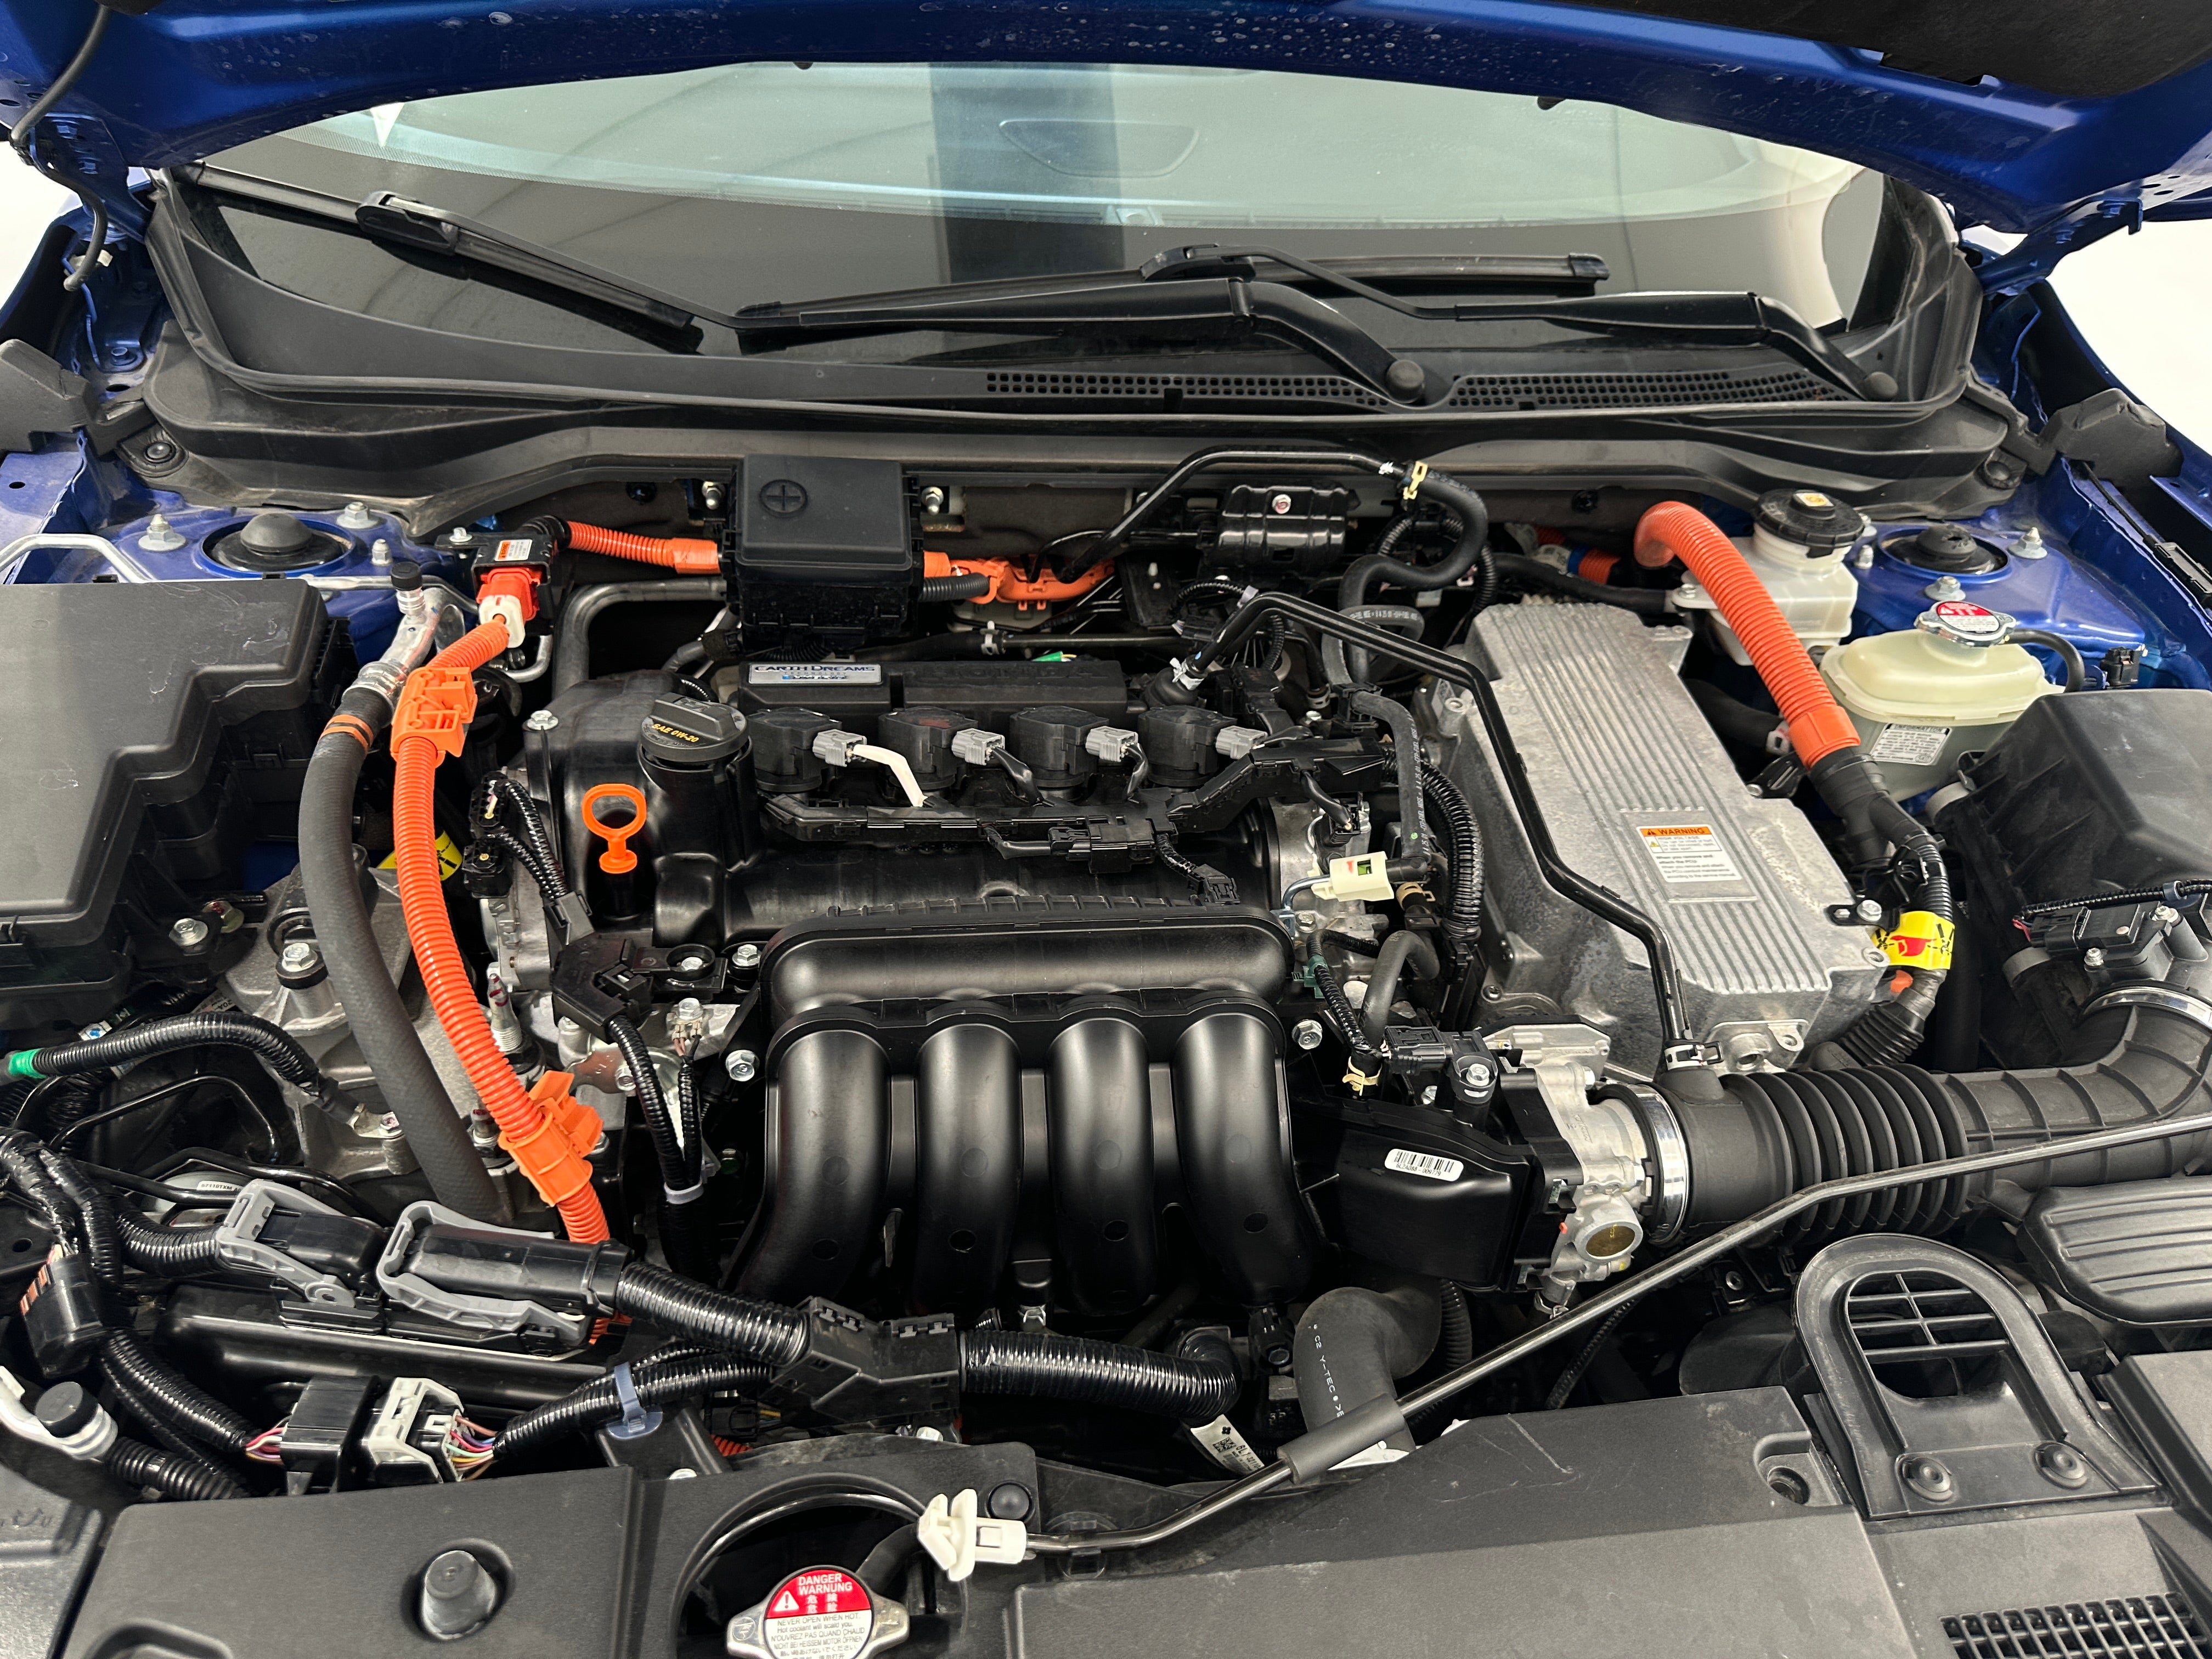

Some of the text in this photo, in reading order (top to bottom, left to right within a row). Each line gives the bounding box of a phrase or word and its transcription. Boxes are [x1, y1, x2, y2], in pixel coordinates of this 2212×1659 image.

[652, 723, 673, 734] SAE
[671, 729, 699, 742] 0W-20
[1314, 1335, 1322, 1349] C2
[1319, 1355, 1335, 1393] Y-TEC
[799, 1573, 842, 1585] DANGER
[799, 1581, 853, 1595] WARNUNG
[777, 1618, 800, 1626] NEVER
[819, 1629, 841, 1638] QUAND
